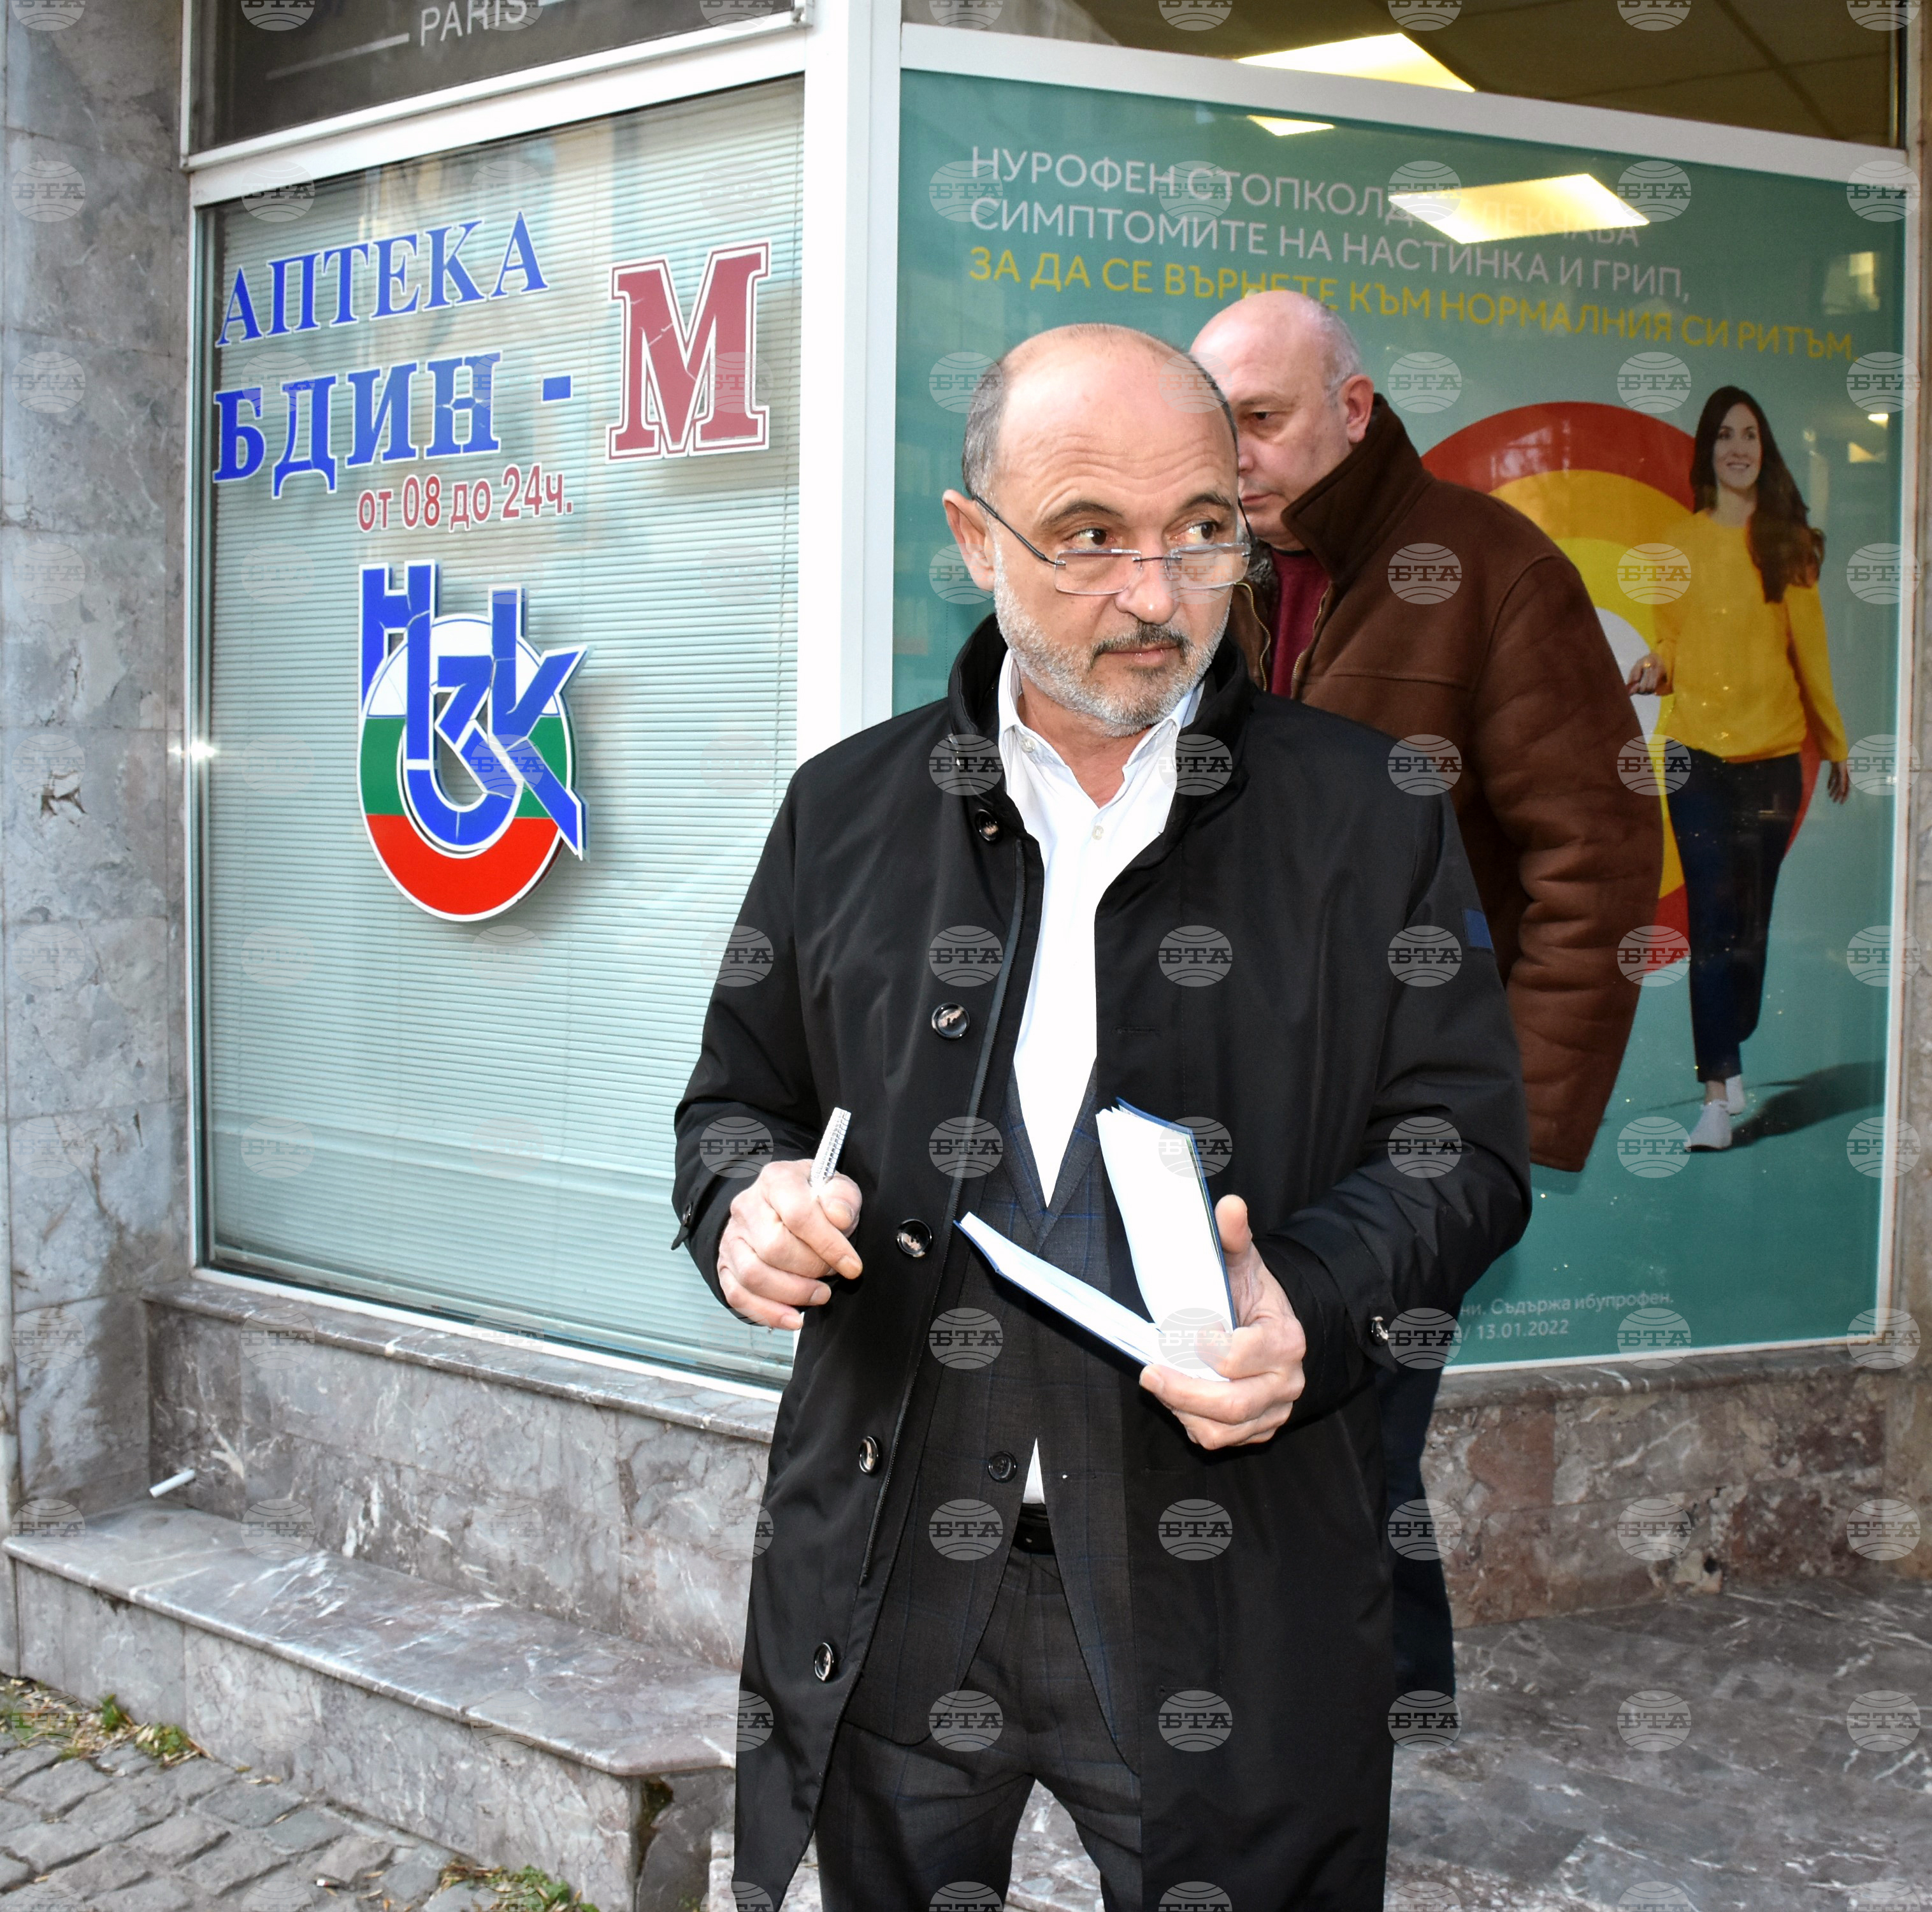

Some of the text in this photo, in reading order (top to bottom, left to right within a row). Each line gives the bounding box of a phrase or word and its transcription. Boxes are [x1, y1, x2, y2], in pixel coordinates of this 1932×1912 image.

[421, 0, 527, 47] PARIS
[972, 145, 1176, 197] НУРОФЕН
[215, 211, 549, 347] АПТЕКА
[970, 196, 1690, 304] СИМПТОМИТЕ НА НАСТИНКА И ГРИП,
[969, 246, 1021, 283] ЗА
[1030, 252, 1092, 293] ДА
[1102, 257, 1153, 293] СЕ
[1349, 280, 1430, 318] КЪМ
[1440, 289, 1672, 343] НОРМАЛНИЯ
[1681, 315, 1729, 347] СИ
[213, 351, 502, 498] БДИН
[605, 238, 771, 463] М
[357, 463, 573, 533] от 08 до 24ч.
[1477, 1319, 1569, 1340] 13.01.2022
[1491, 1298, 1571, 1316] Съдържа
[1575, 1291, 1675, 1312] ибупрофен.
